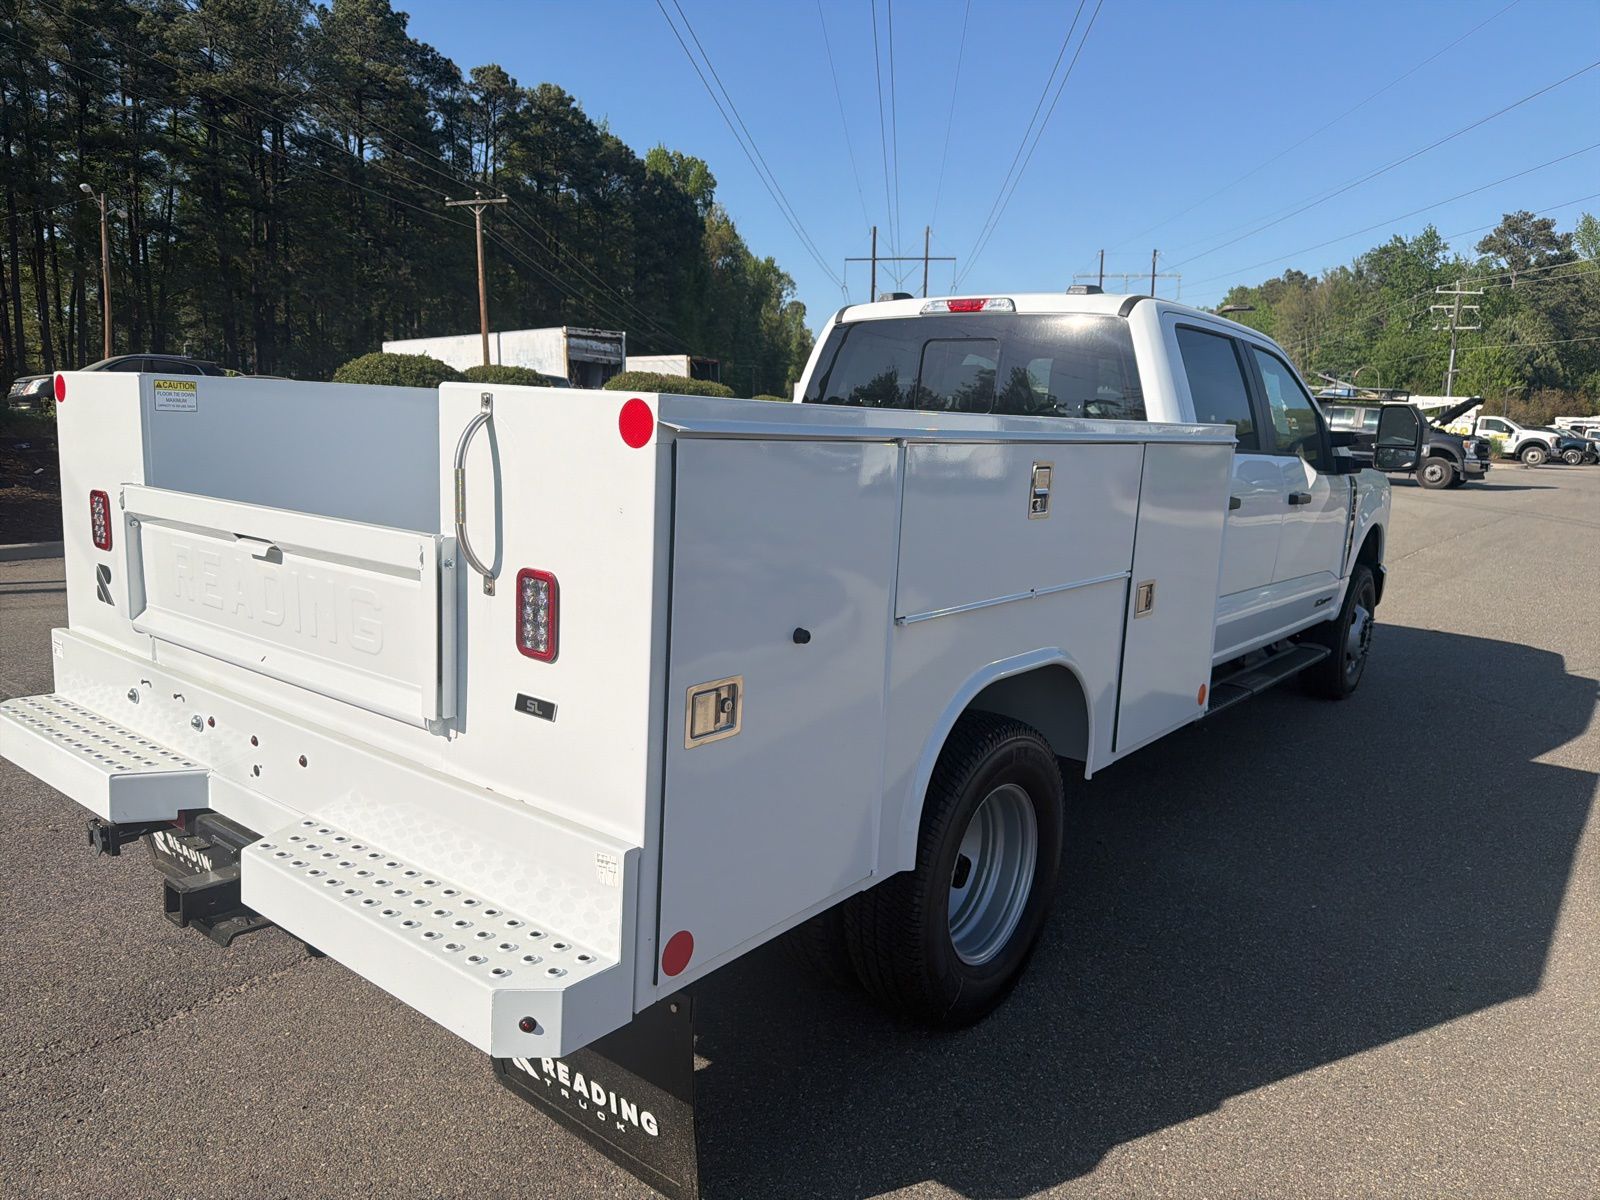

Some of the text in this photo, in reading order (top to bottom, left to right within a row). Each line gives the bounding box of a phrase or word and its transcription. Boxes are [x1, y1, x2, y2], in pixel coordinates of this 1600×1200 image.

[162, 381, 195, 390] CAUTION
[169, 543, 384, 656] READING
[526, 699, 543, 715] SL
[541, 1057, 659, 1137] READING
[544, 1077, 626, 1134] TRUCK
